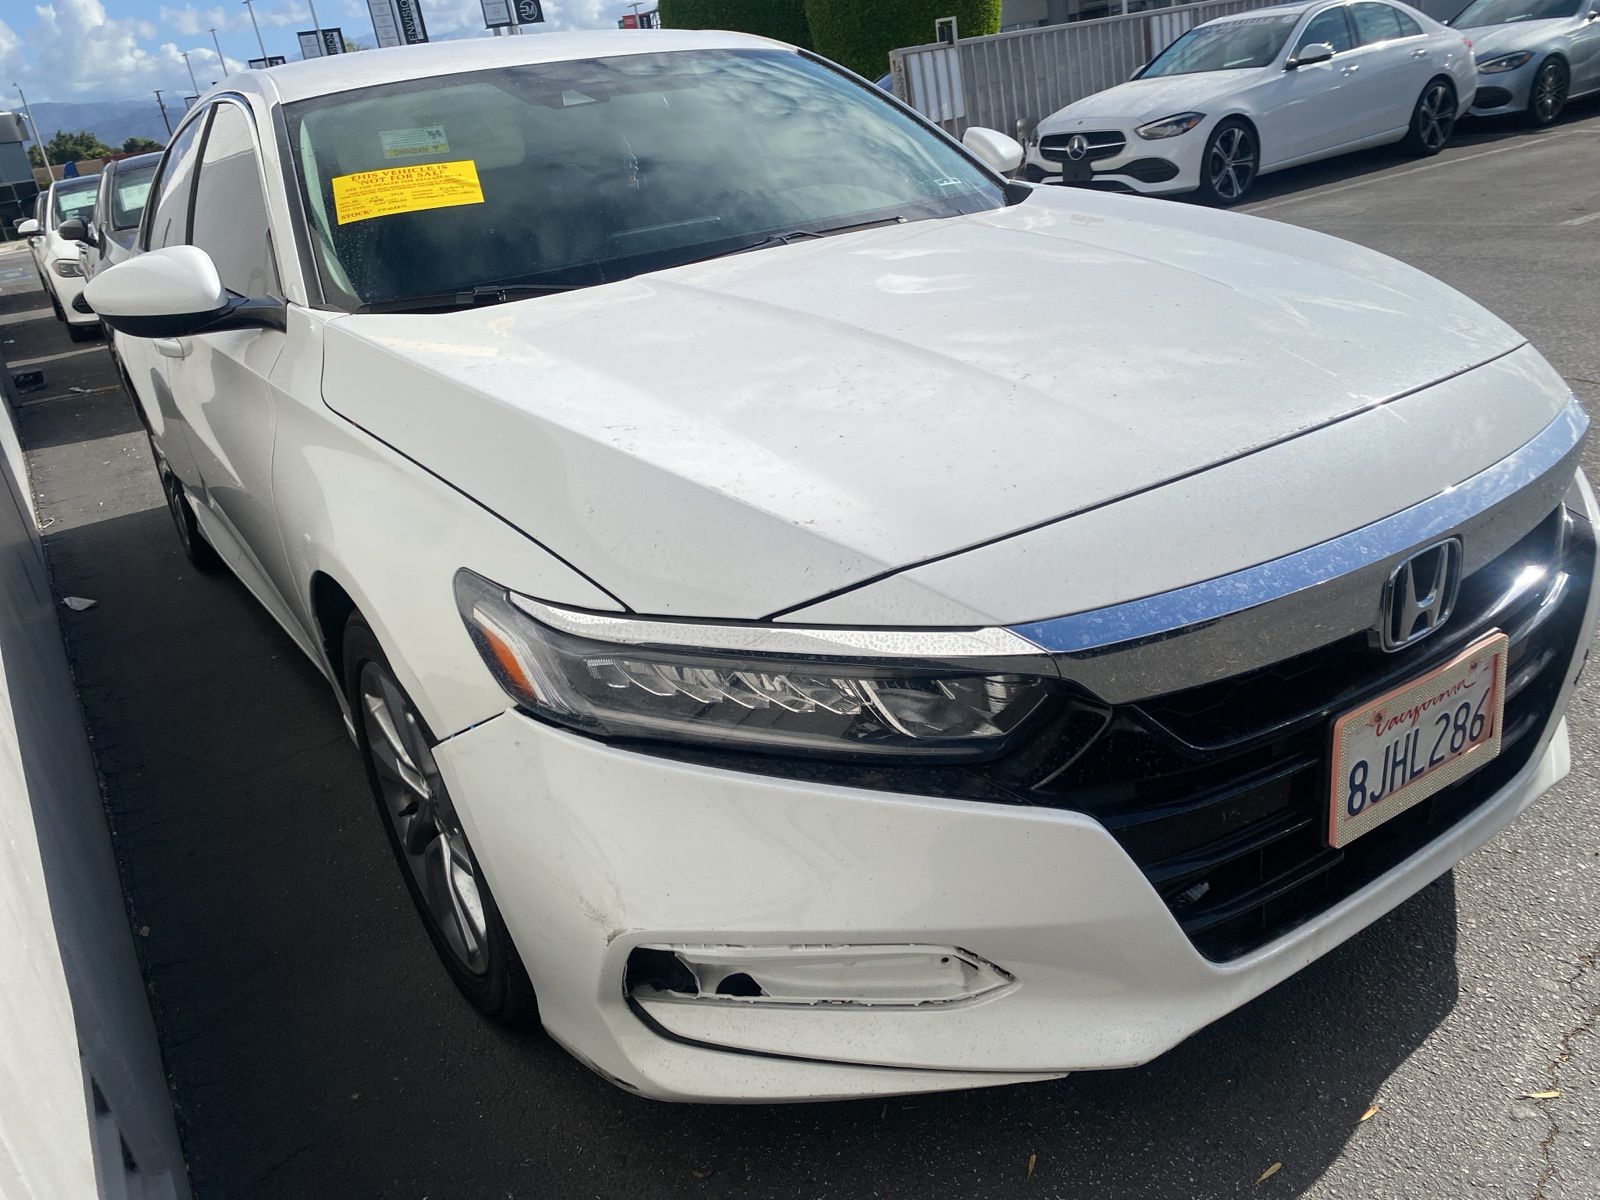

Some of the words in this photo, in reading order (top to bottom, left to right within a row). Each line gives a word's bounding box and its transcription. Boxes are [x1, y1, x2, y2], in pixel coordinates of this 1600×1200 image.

[351, 172, 378, 182] THIS
[382, 165, 434, 176] VEHICLE
[361, 176, 386, 185] NOT
[390, 173, 413, 181] FOR
[417, 169, 445, 177] SALE
[1347, 688, 1490, 816] 8JHL286
